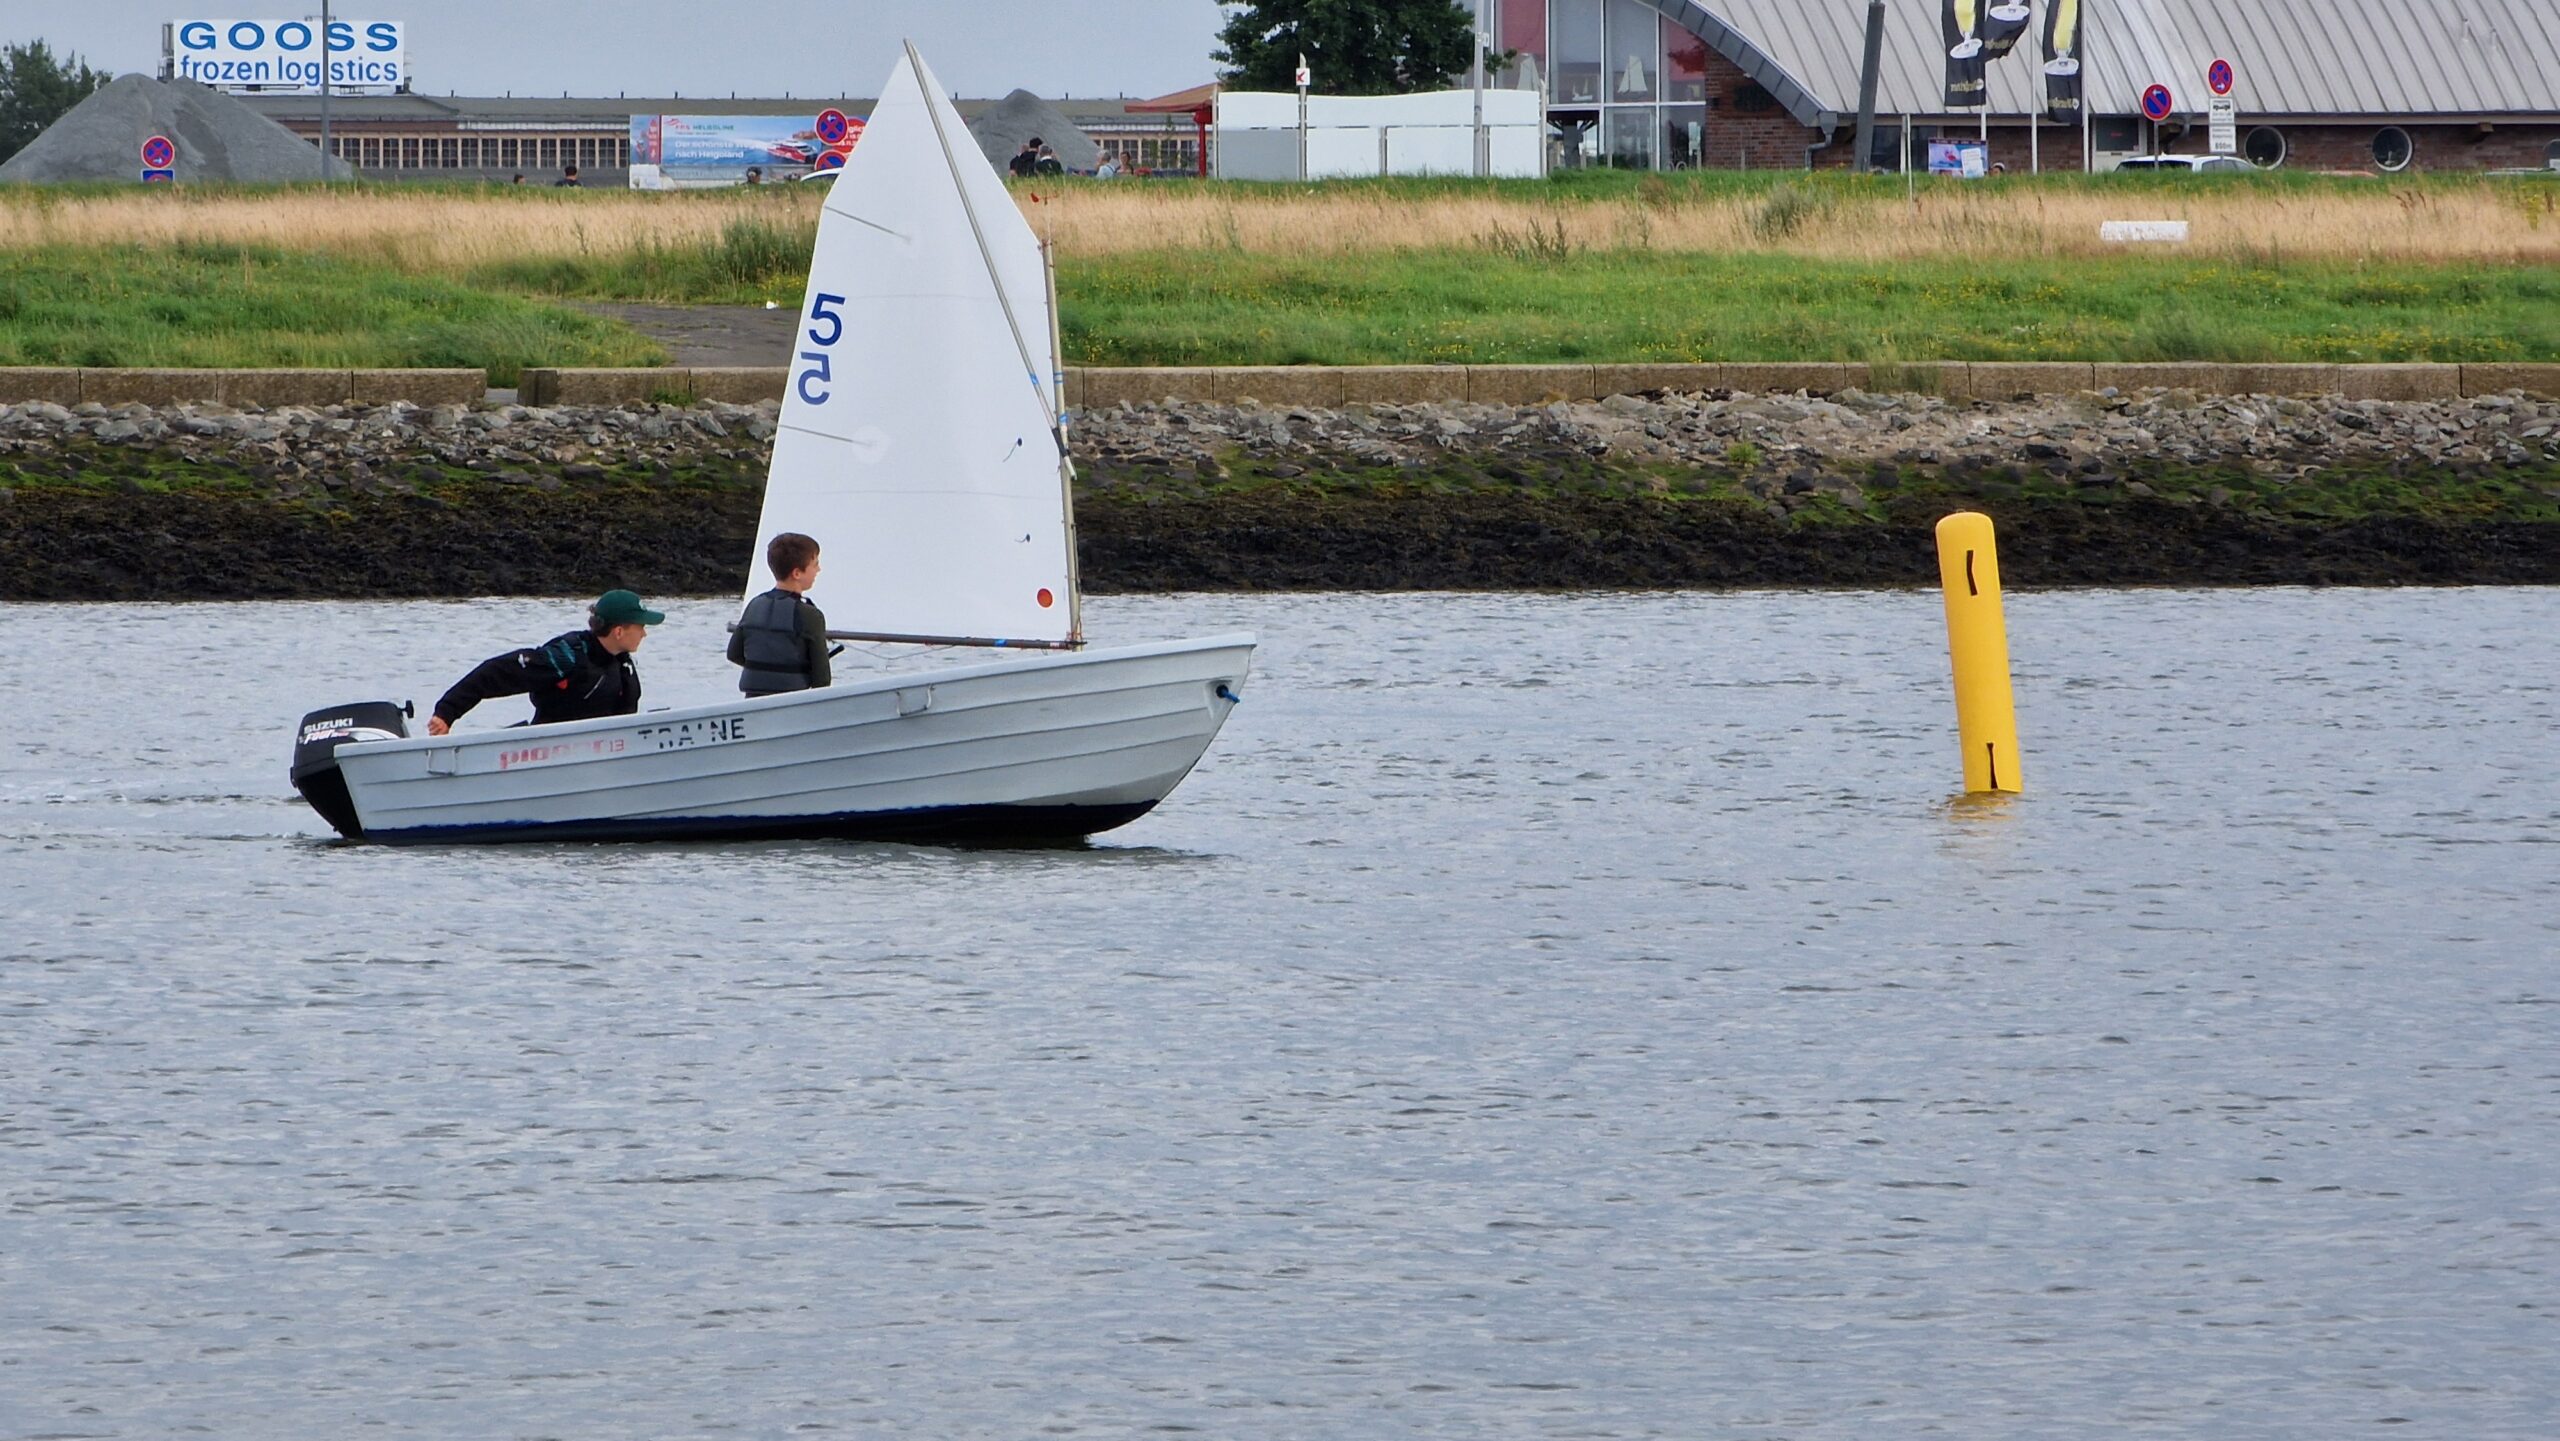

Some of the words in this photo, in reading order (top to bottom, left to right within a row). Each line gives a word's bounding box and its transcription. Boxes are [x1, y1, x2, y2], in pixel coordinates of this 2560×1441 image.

[180, 22, 398, 51] GOOSS
[181, 55, 270, 82] frozen
[278, 56, 398, 86] logstics
[675, 151, 698, 159] nach
[699, 151, 744, 160] Helgoland
[809, 293, 846, 346] 5
[304, 718, 354, 735] SUZUKI
[609, 739, 625, 753] 13
